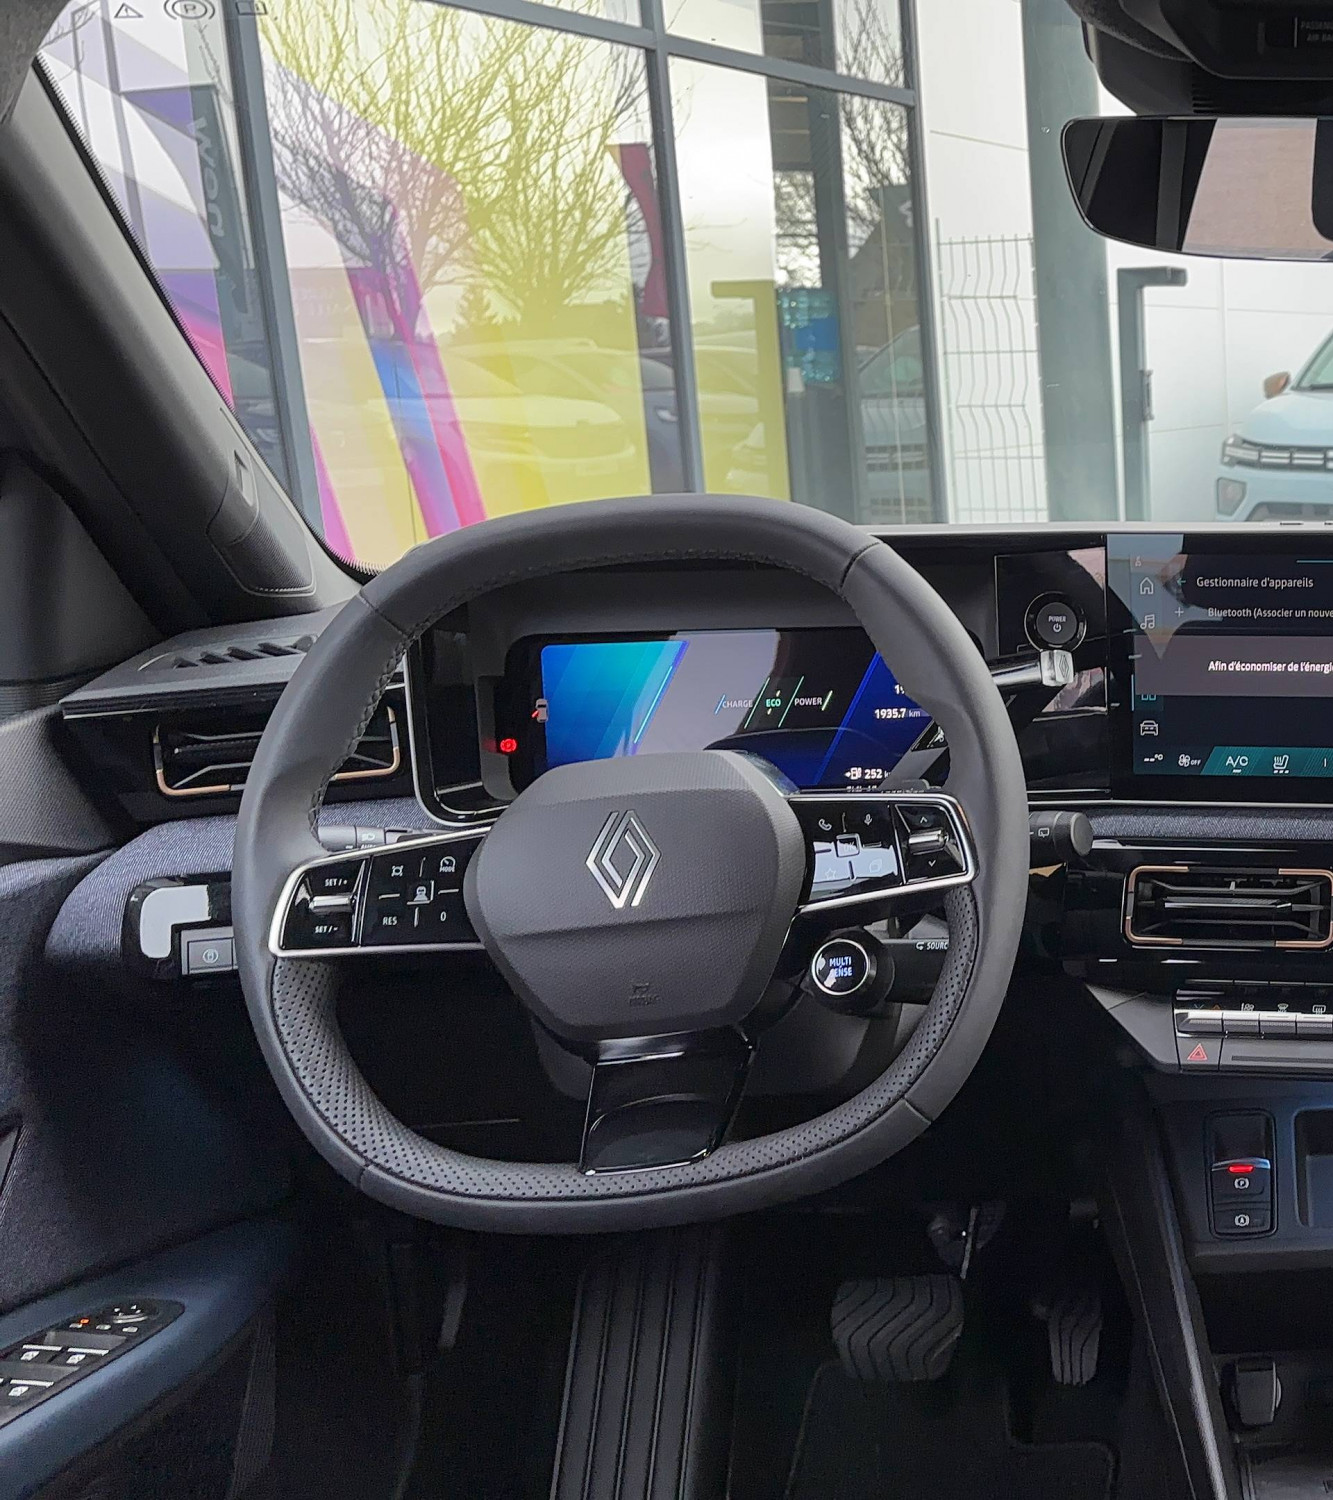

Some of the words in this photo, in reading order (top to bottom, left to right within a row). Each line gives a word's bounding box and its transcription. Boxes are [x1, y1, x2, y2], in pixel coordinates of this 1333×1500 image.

[1196, 577, 1259, 588] Gestionnaire
[1260, 577, 1314, 590] d'appareils
[1207, 607, 1252, 618] Bluetooth
[1253, 607, 1293, 619] (Associer
[1295, 610, 1306, 618] un
[1208, 661, 1227, 671] Afin
[1228, 661, 1286, 672] d'économiser
[1287, 662, 1299, 672] de
[722, 700, 753, 708] CHARGE
[766, 698, 781, 707] ECO
[794, 697, 823, 706] POWER
[875, 708, 907, 719] 1935.7
[1225, 755, 1249, 768] A/C
[865, 769, 883, 779] 252
[382, 916, 398, 926] RES
[829, 957, 852, 967] MULTI
